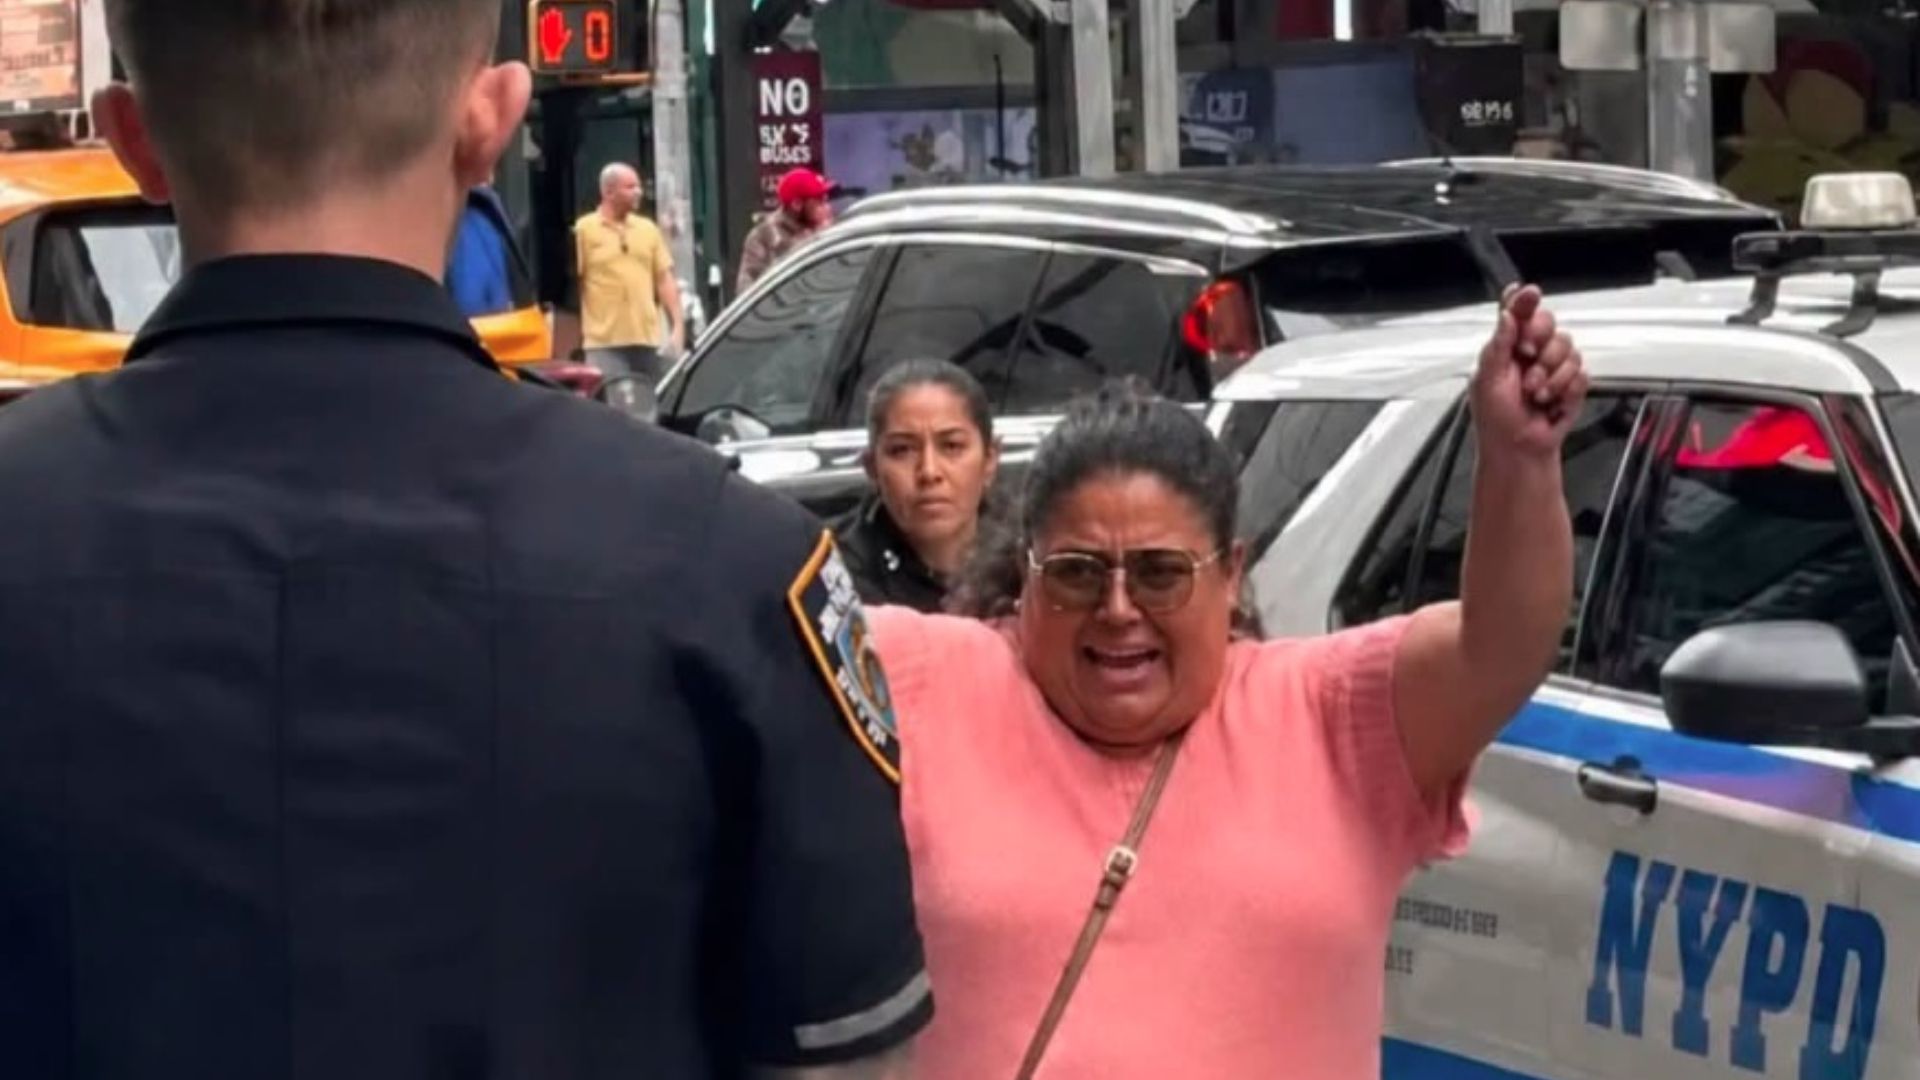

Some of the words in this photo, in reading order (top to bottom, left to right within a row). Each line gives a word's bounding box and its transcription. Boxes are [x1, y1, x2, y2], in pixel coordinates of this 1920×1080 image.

[585, 9, 609, 59] 0
[760, 77, 809, 116] NO
[1586, 850, 1886, 1080] NYPD
